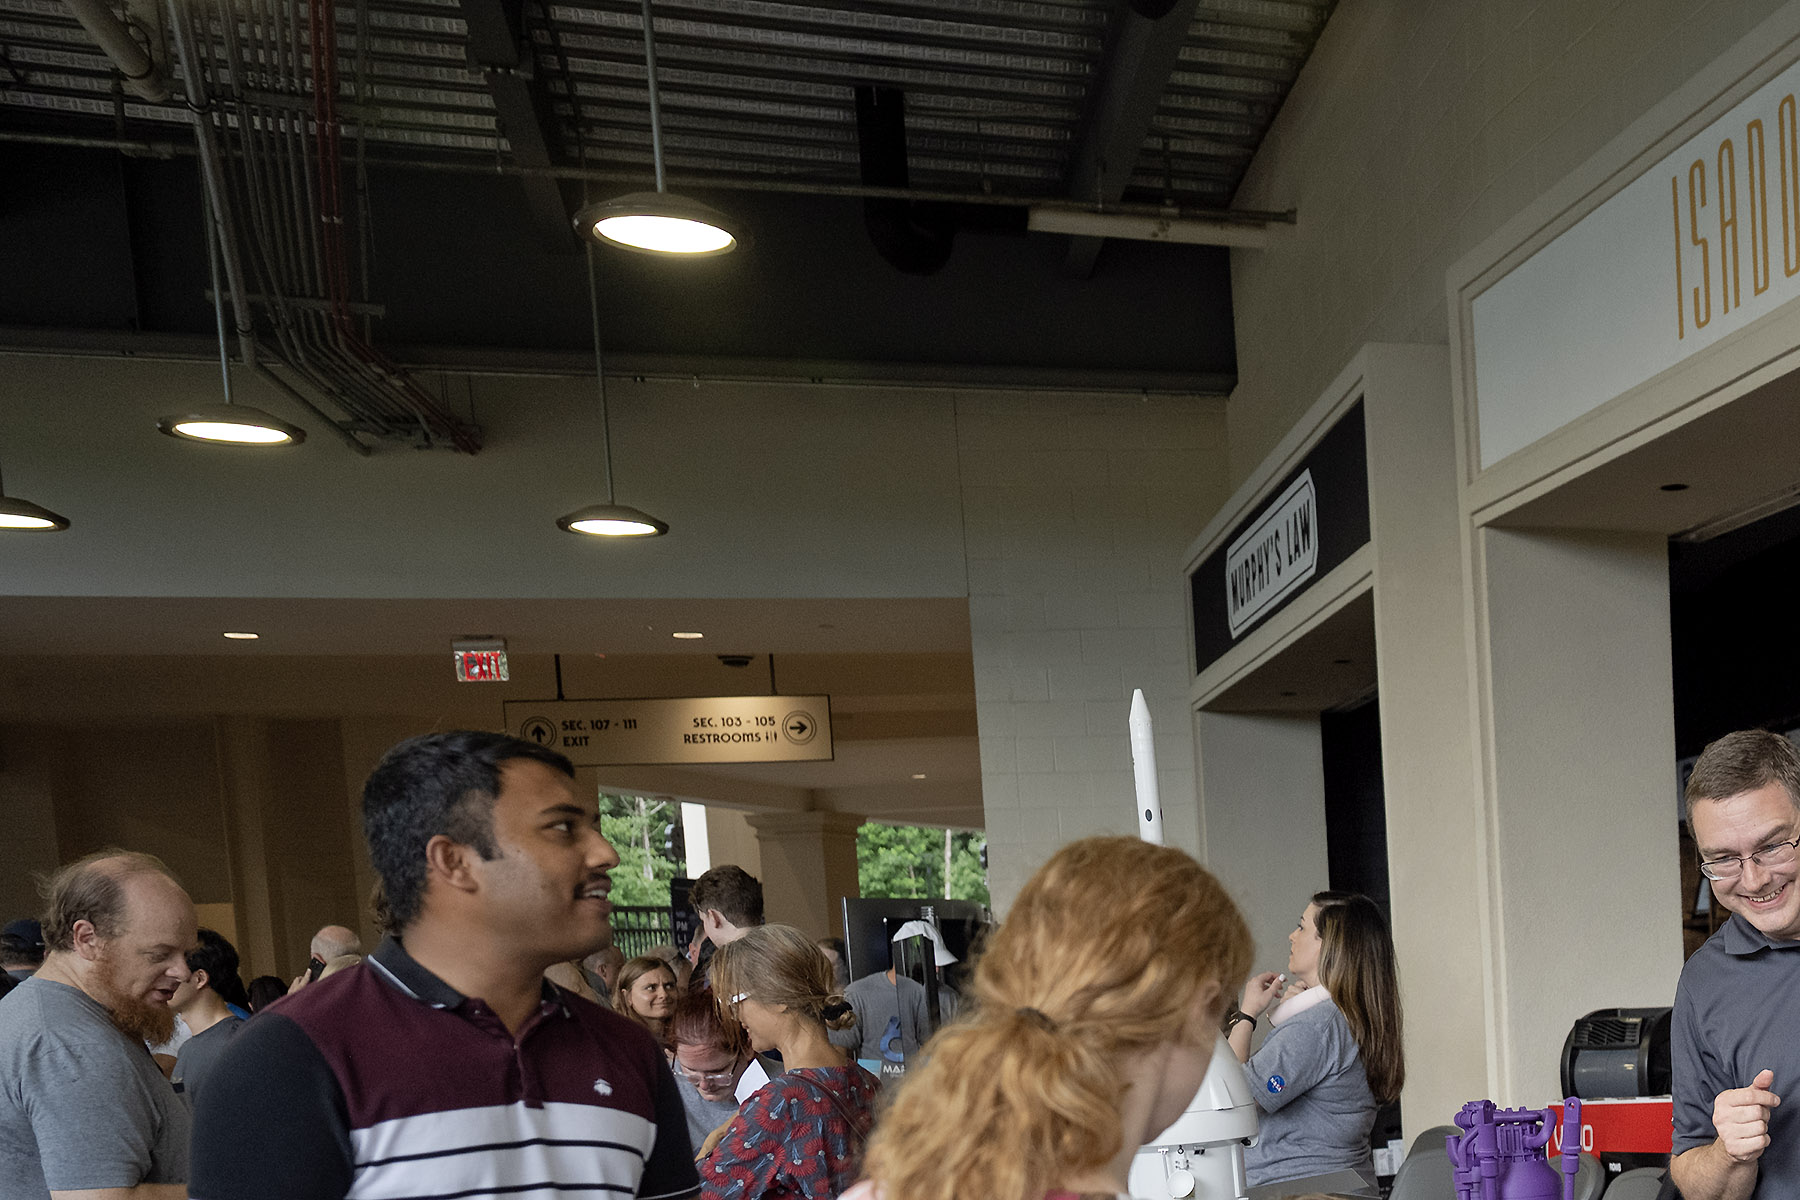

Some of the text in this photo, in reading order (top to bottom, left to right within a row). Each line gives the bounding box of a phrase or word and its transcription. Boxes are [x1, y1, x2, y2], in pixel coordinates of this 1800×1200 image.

[1230, 499, 1311, 615] MURPHY'S LAW
[463, 652, 500, 680] EXIT
[561, 719, 586, 731] SEC.
[590, 719, 610, 730] 107
[622, 718, 637, 729] 111
[692, 717, 717, 728] SEC.
[721, 716, 742, 727] 103
[755, 715, 776, 726] 105
[562, 735, 589, 747] EXIT
[683, 732, 761, 744] RESTROOMS
